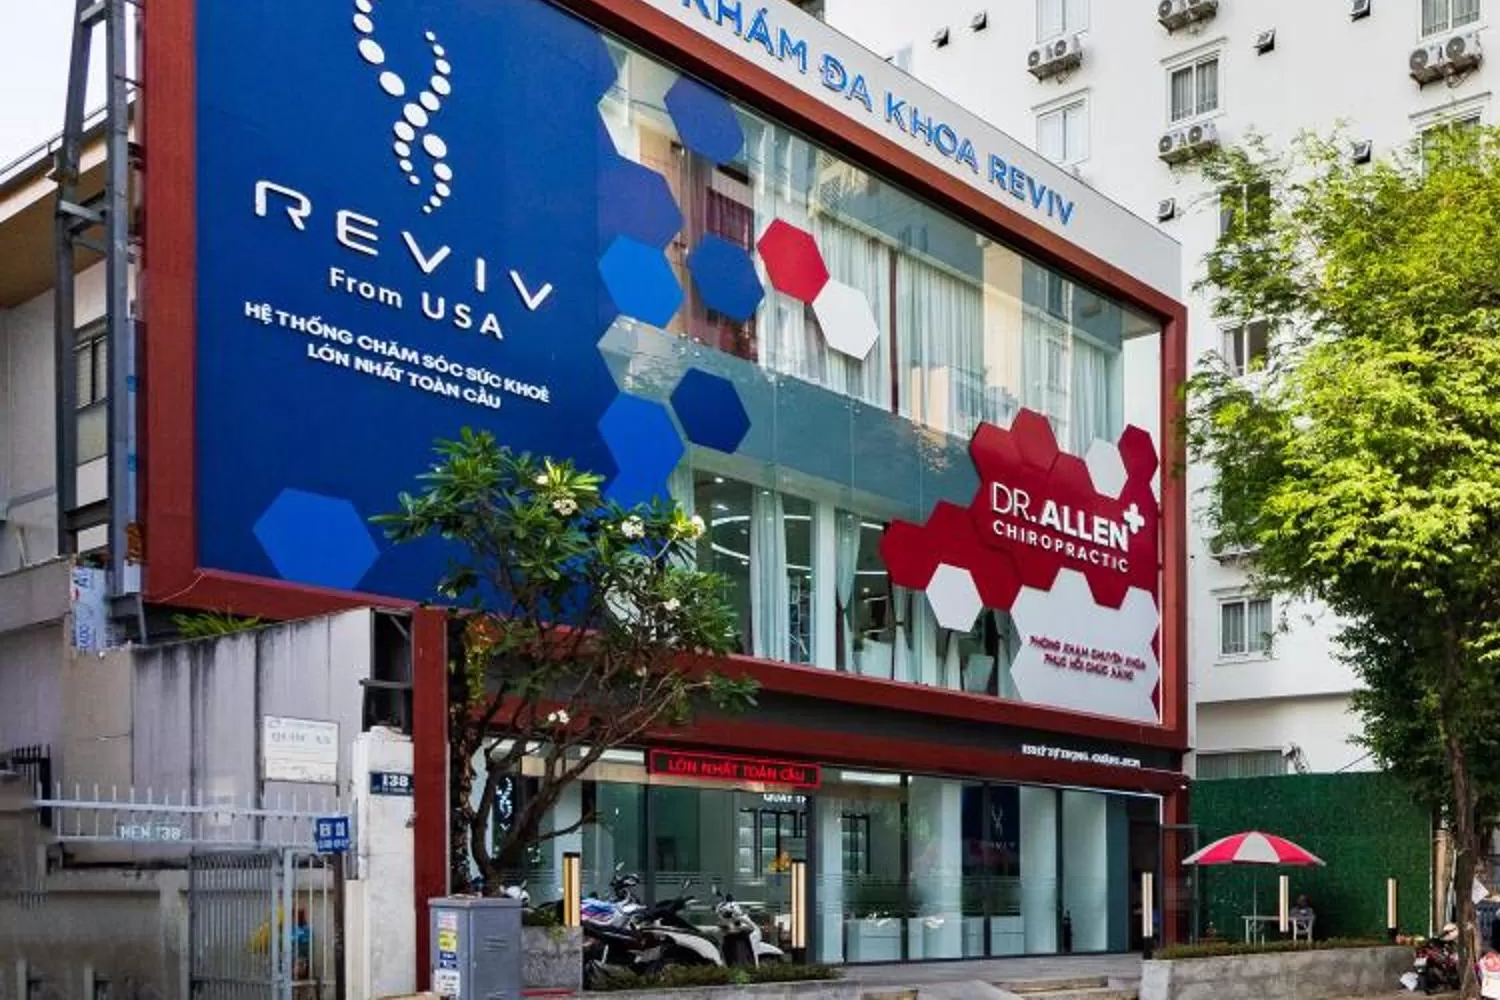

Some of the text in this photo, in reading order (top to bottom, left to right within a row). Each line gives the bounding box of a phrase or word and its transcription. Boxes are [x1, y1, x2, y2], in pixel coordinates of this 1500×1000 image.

[819, 53, 873, 113] ĐA
[884, 91, 980, 175] KHOA
[988, 153, 1074, 226] REVIV
[254, 180, 553, 312] REVIV
[329, 267, 504, 340] From USA
[244, 301, 273, 326] HỆ
[275, 310, 353, 345] THỐNG
[356, 334, 420, 366] CHĂM
[422, 354, 465, 377] SÓC
[465, 367, 502, 389] SỨC
[307, 342, 501, 409] LỚN NHẤT TOÀN CẦU
[992, 519, 1130, 573] CHIROPRACTIC
